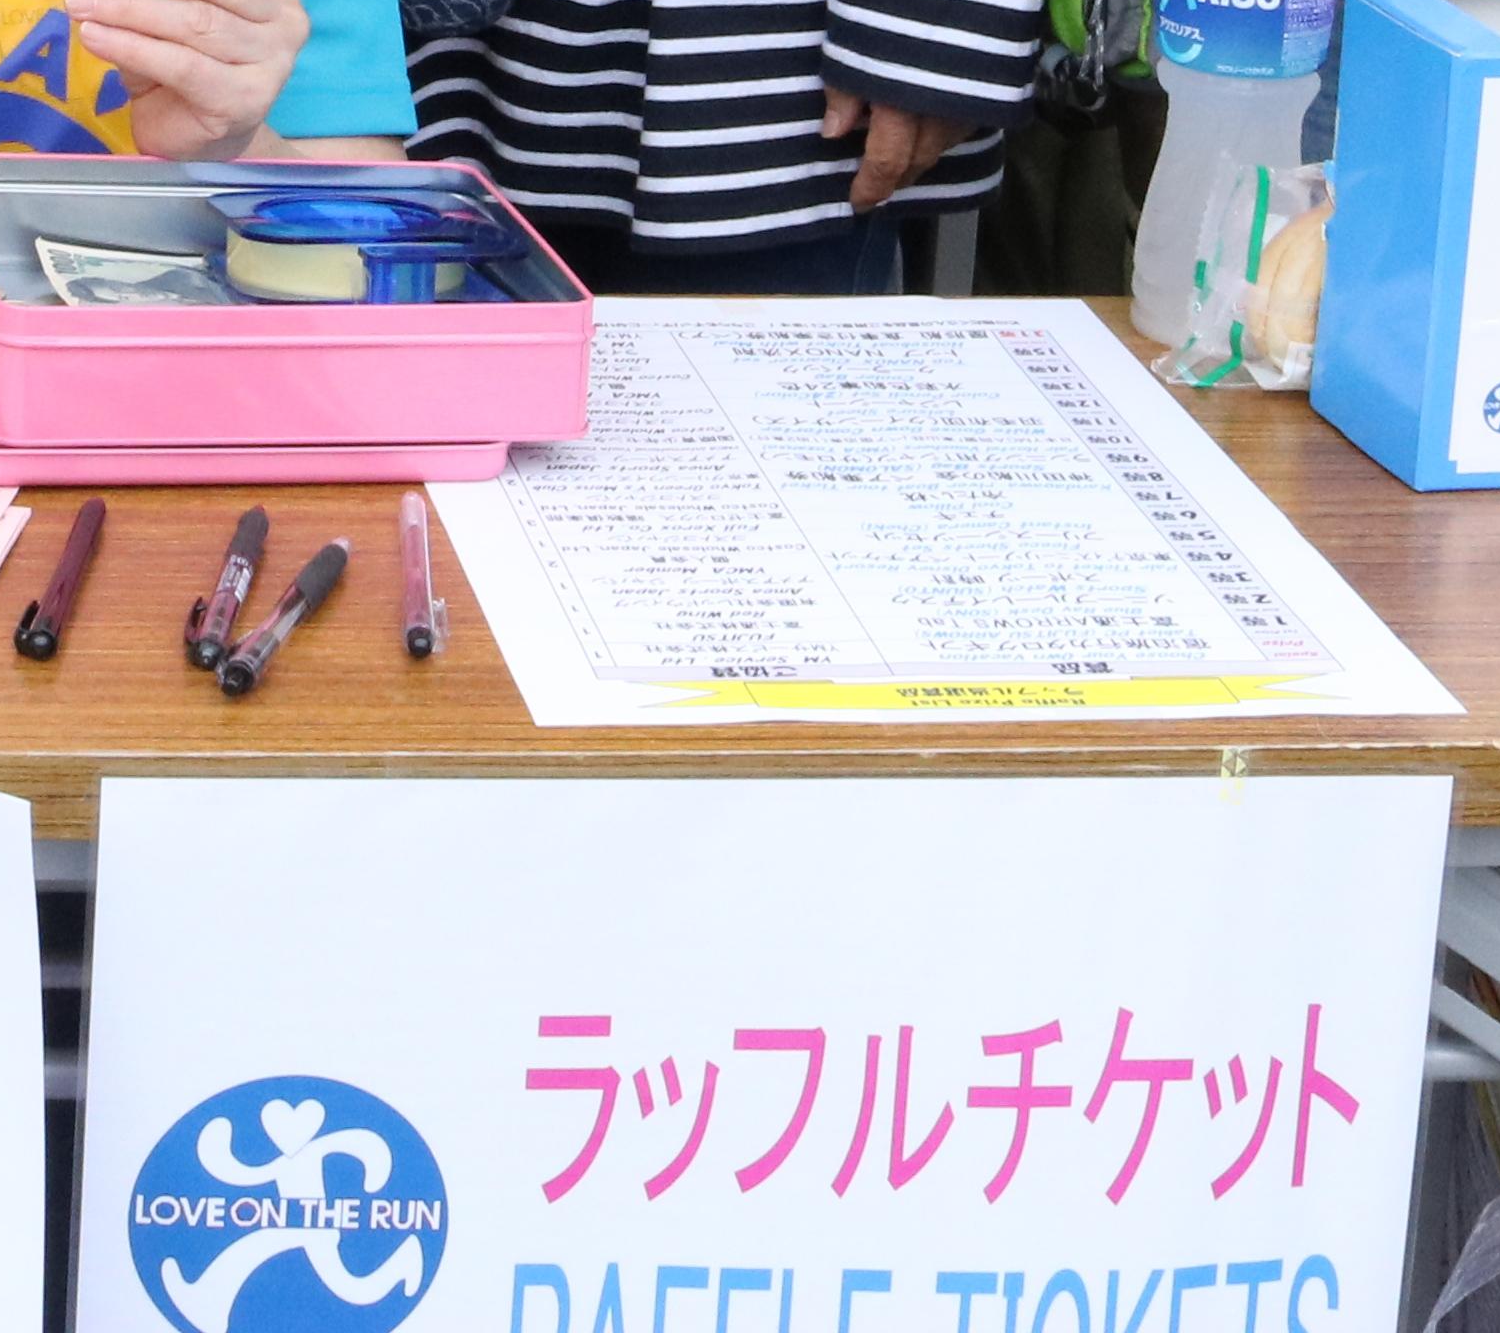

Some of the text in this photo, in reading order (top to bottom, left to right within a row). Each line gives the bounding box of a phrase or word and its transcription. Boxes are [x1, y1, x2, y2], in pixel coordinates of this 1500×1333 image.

[522, 1001, 1362, 1208] ラッフルチケット
[134, 1193, 442, 1231] LOVE ON THE RUN
